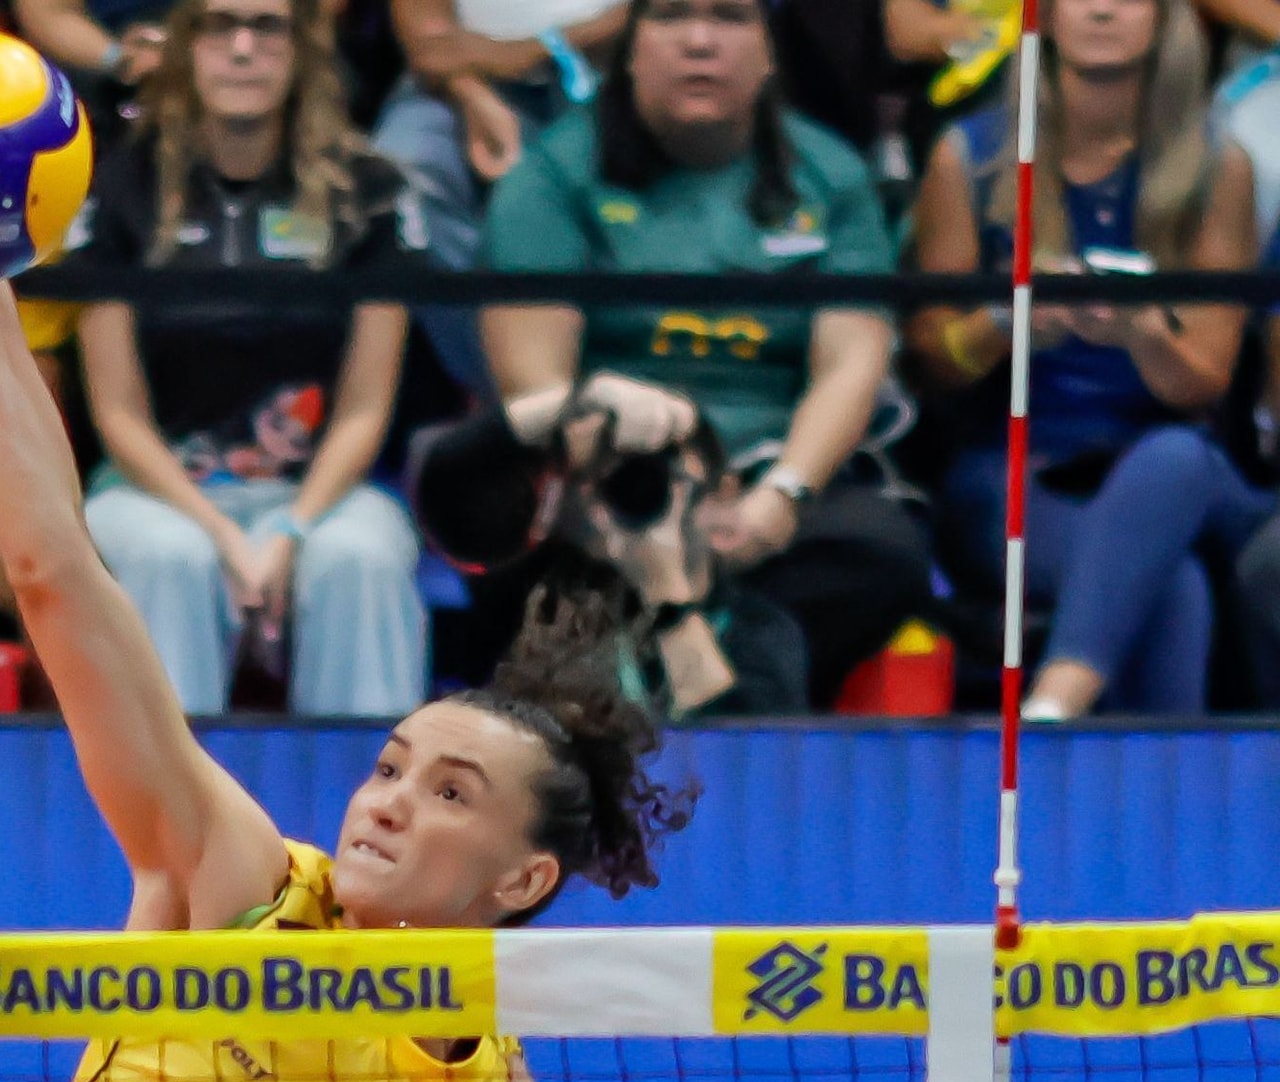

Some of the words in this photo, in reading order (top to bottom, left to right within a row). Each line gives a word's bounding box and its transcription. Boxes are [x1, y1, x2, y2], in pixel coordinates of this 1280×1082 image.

[173, 966, 249, 1012] DO
[261, 955, 464, 1013] BRASIL
[1054, 962, 1126, 1008] DO
